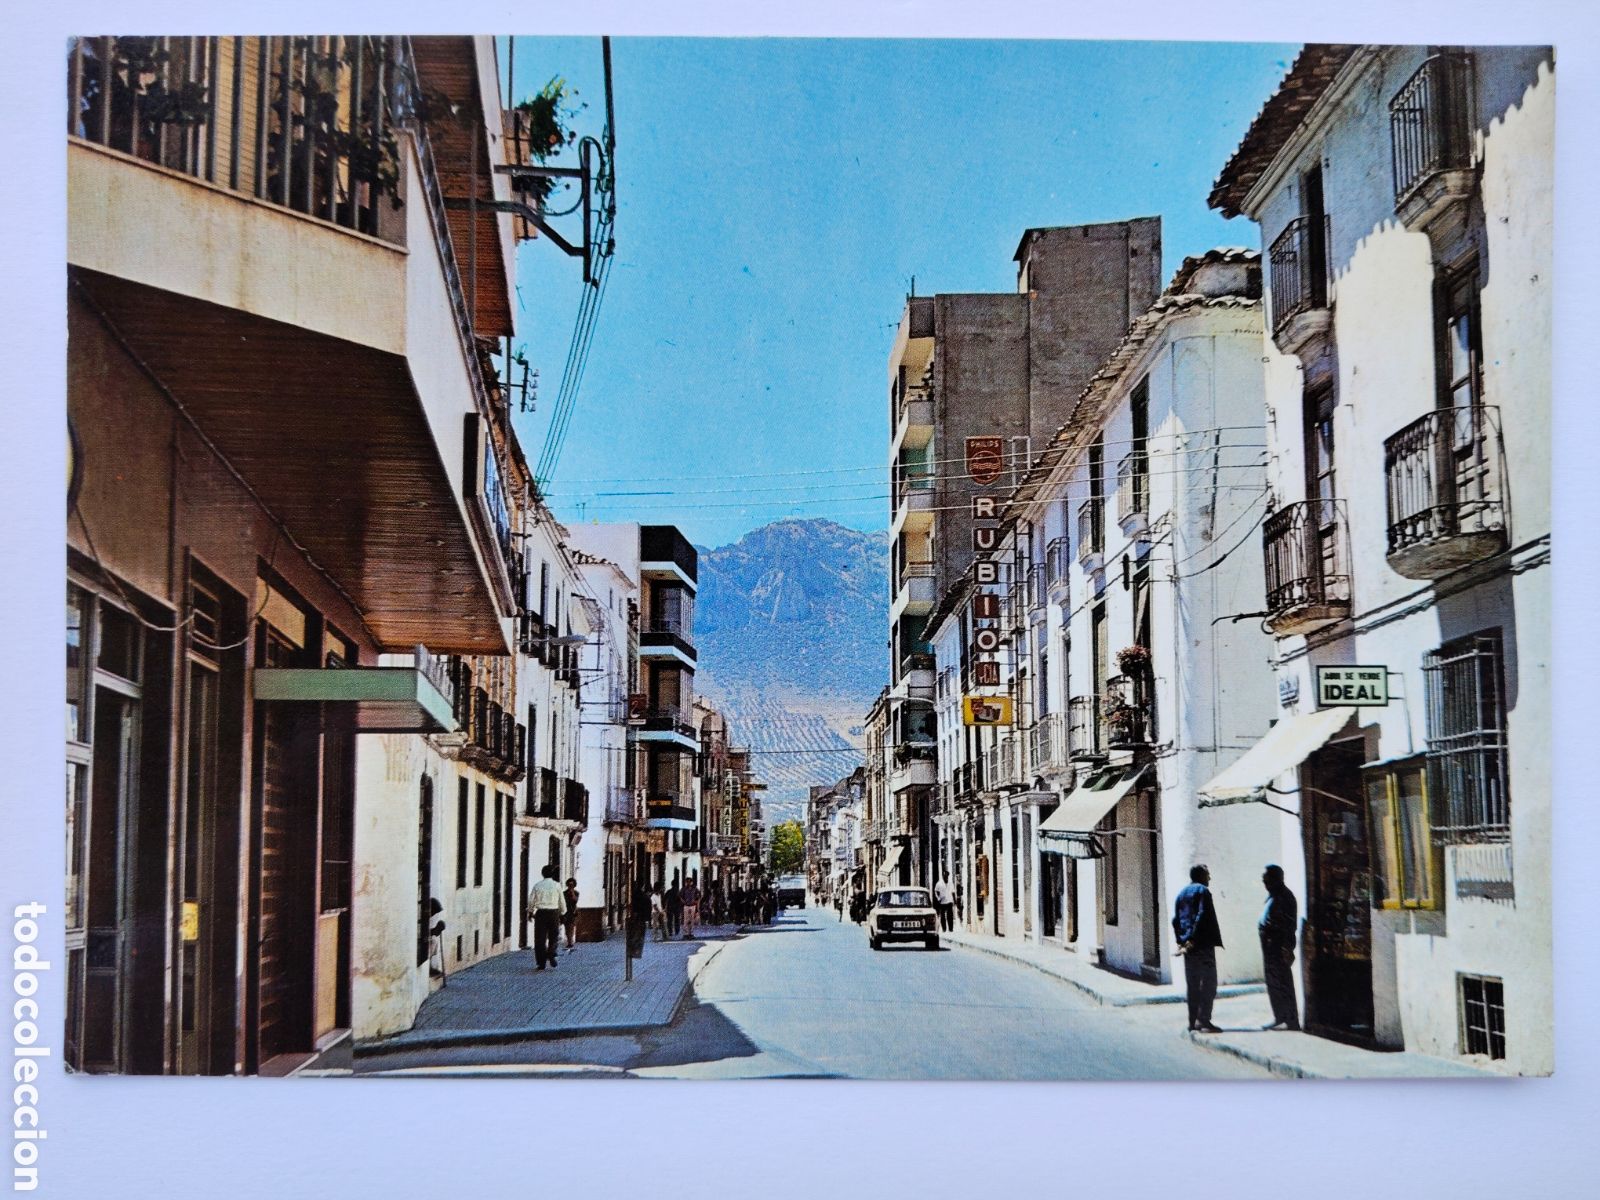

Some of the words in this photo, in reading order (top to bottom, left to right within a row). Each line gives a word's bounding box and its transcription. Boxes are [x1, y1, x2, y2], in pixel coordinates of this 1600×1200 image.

[977, 499, 997, 650] RUBIO
[1345, 672, 1353, 680] SE
[1324, 684, 1381, 700] IDEAL
